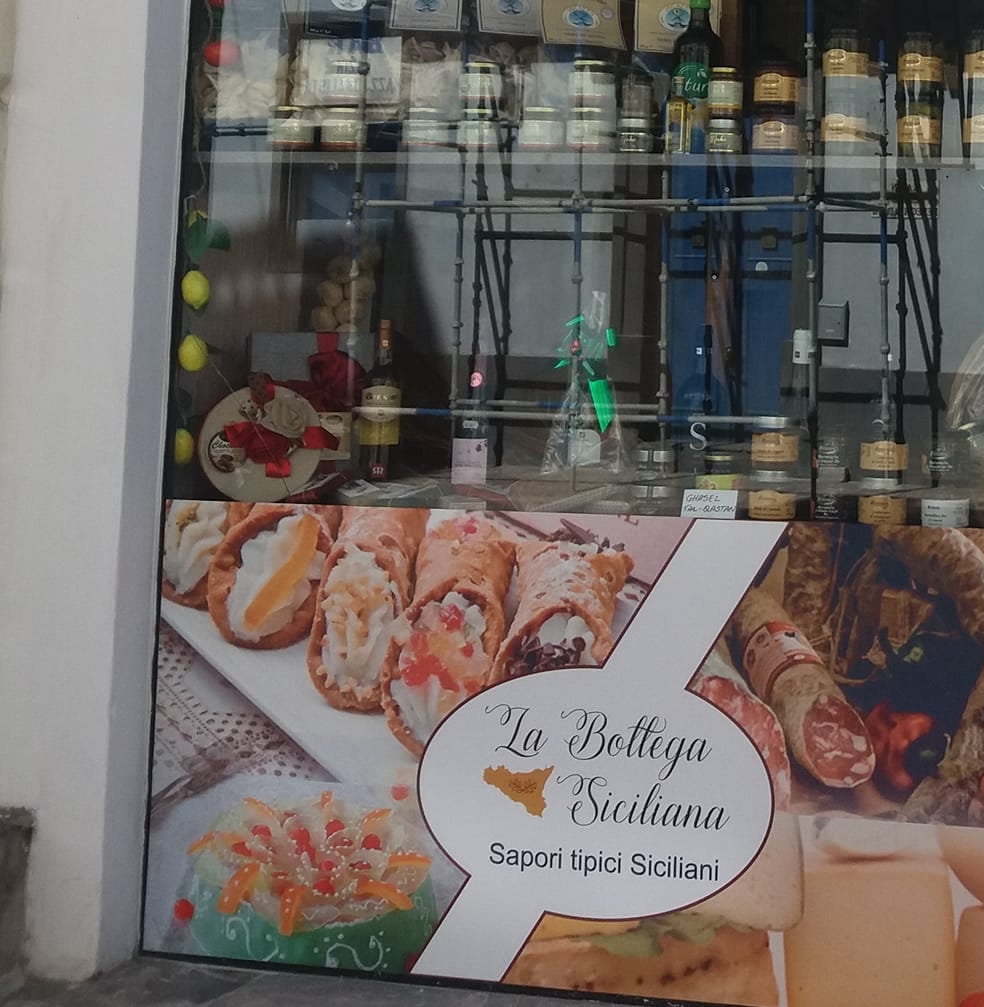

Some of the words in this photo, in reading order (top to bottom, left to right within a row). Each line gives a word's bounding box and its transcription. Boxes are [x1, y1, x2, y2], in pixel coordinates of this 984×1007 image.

[485, 703, 549, 757] La
[560, 709, 712, 781] Bottega
[556, 773, 731, 831] Siciliana
[489, 842, 562, 873] Sapori
[570, 848, 622, 877] tipici
[630, 853, 719, 882] Siciliani
